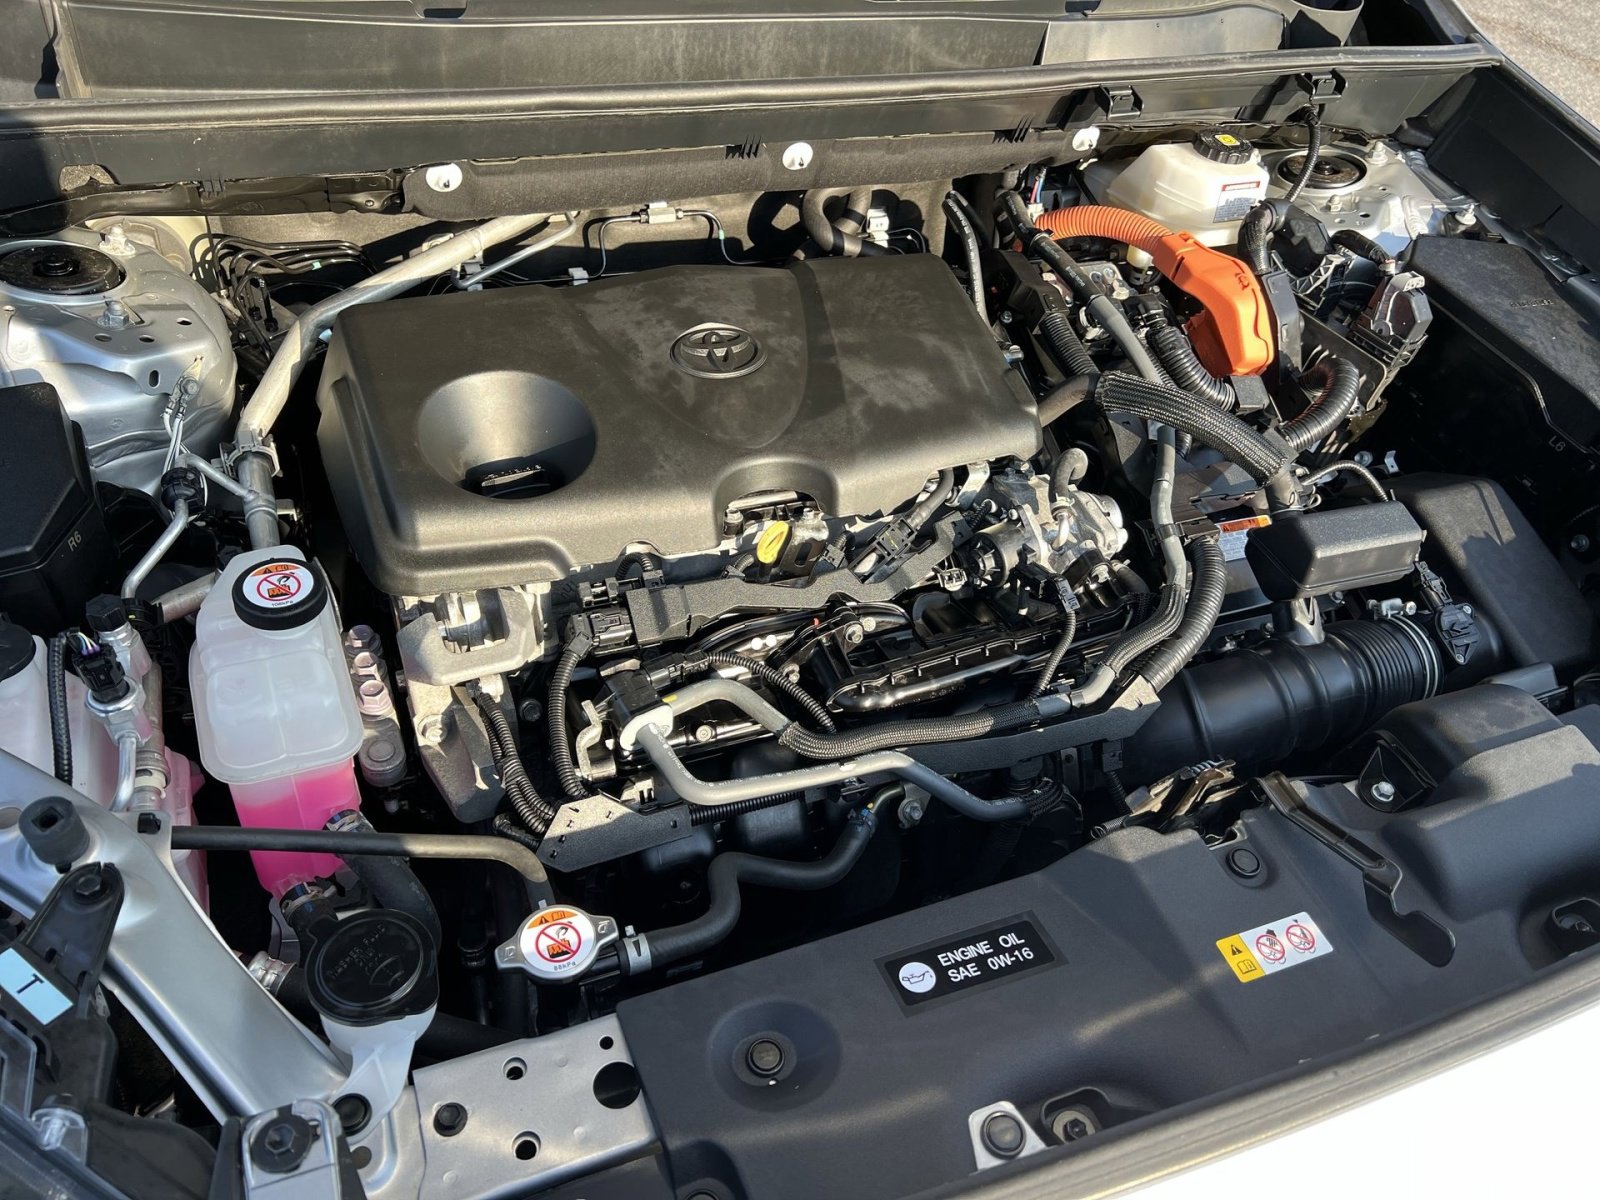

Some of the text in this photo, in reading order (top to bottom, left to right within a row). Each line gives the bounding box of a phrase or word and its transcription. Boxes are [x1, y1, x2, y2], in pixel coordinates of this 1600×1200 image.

[1548, 434, 1566, 452] L6
[67, 530, 82, 552] R6
[937, 932, 1026, 967] ENGINE OIL
[947, 947, 1034, 982] SAE 0W-16
[16, 973, 45, 994] T
